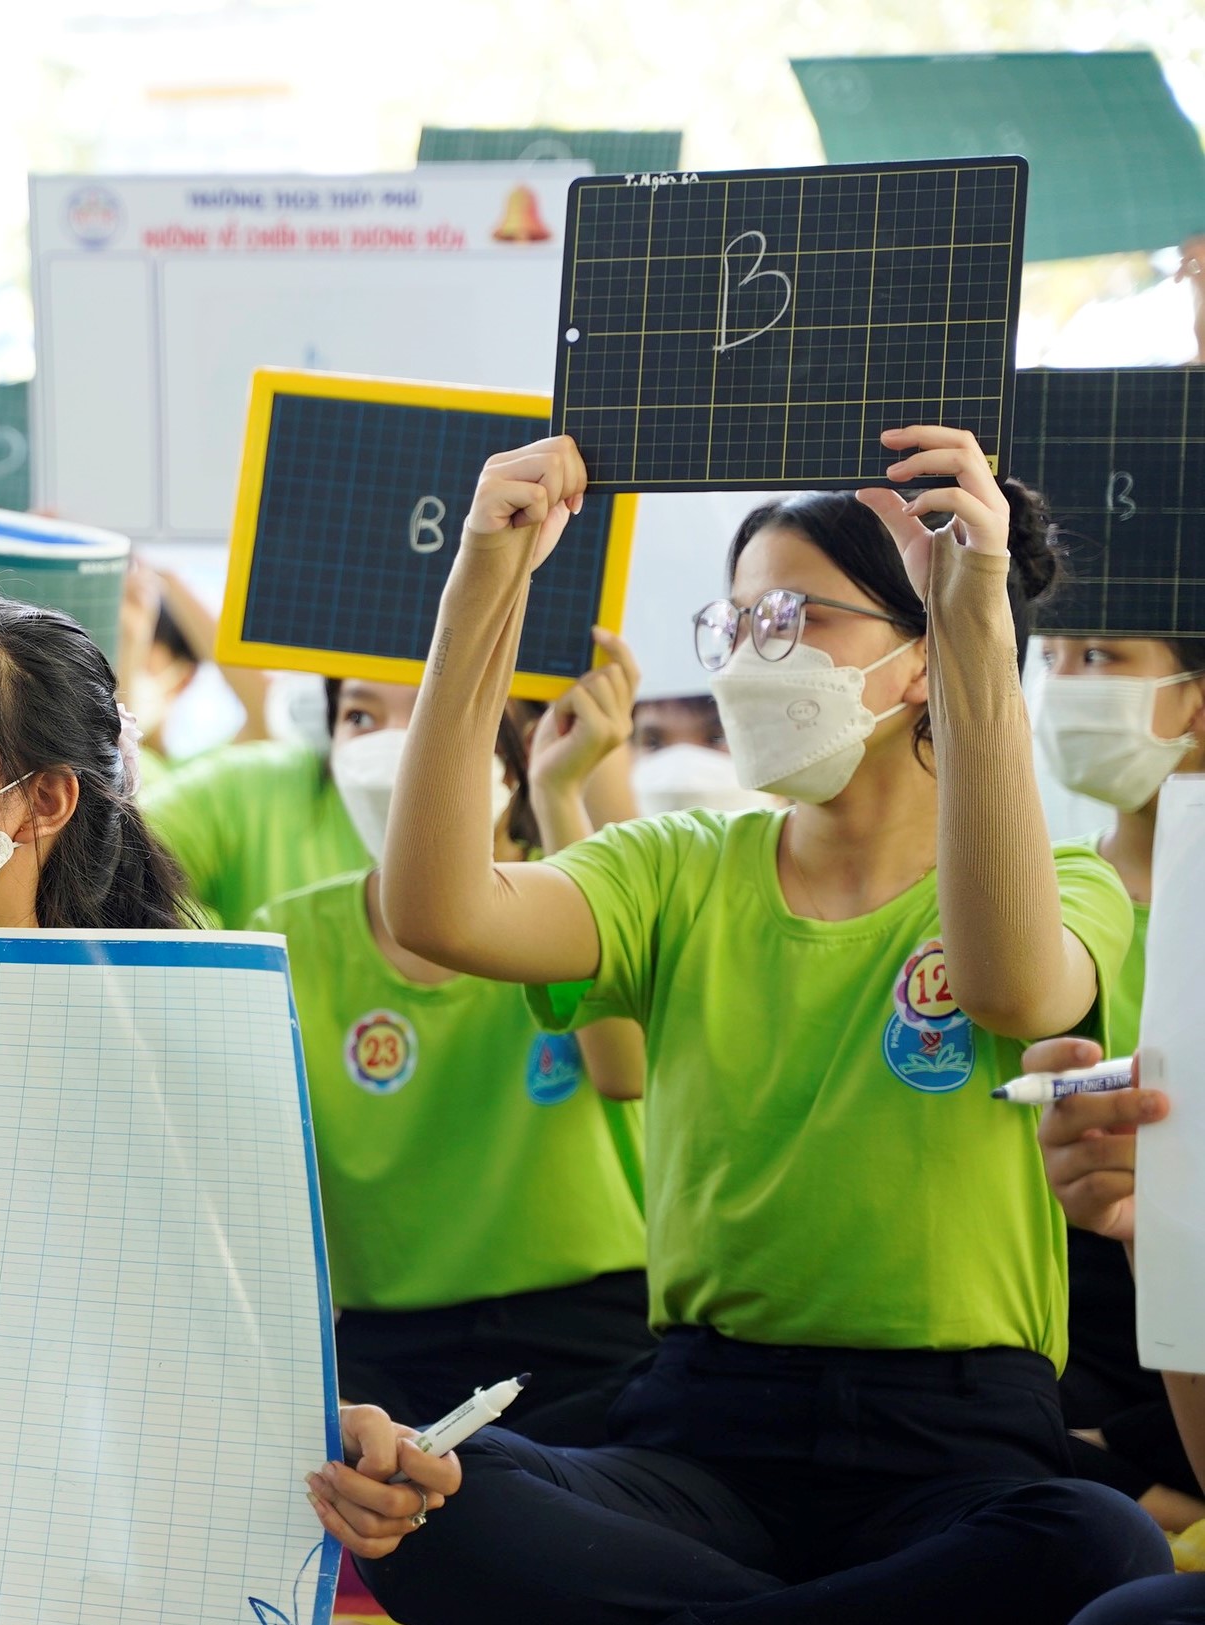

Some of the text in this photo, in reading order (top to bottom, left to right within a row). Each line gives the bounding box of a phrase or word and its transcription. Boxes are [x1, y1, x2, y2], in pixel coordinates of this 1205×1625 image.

[712, 230, 792, 353] B
[1106, 470, 1136, 521] B
[409, 495, 446, 554] B
[916, 964, 953, 1005] 12
[365, 1035, 399, 1068] 23
